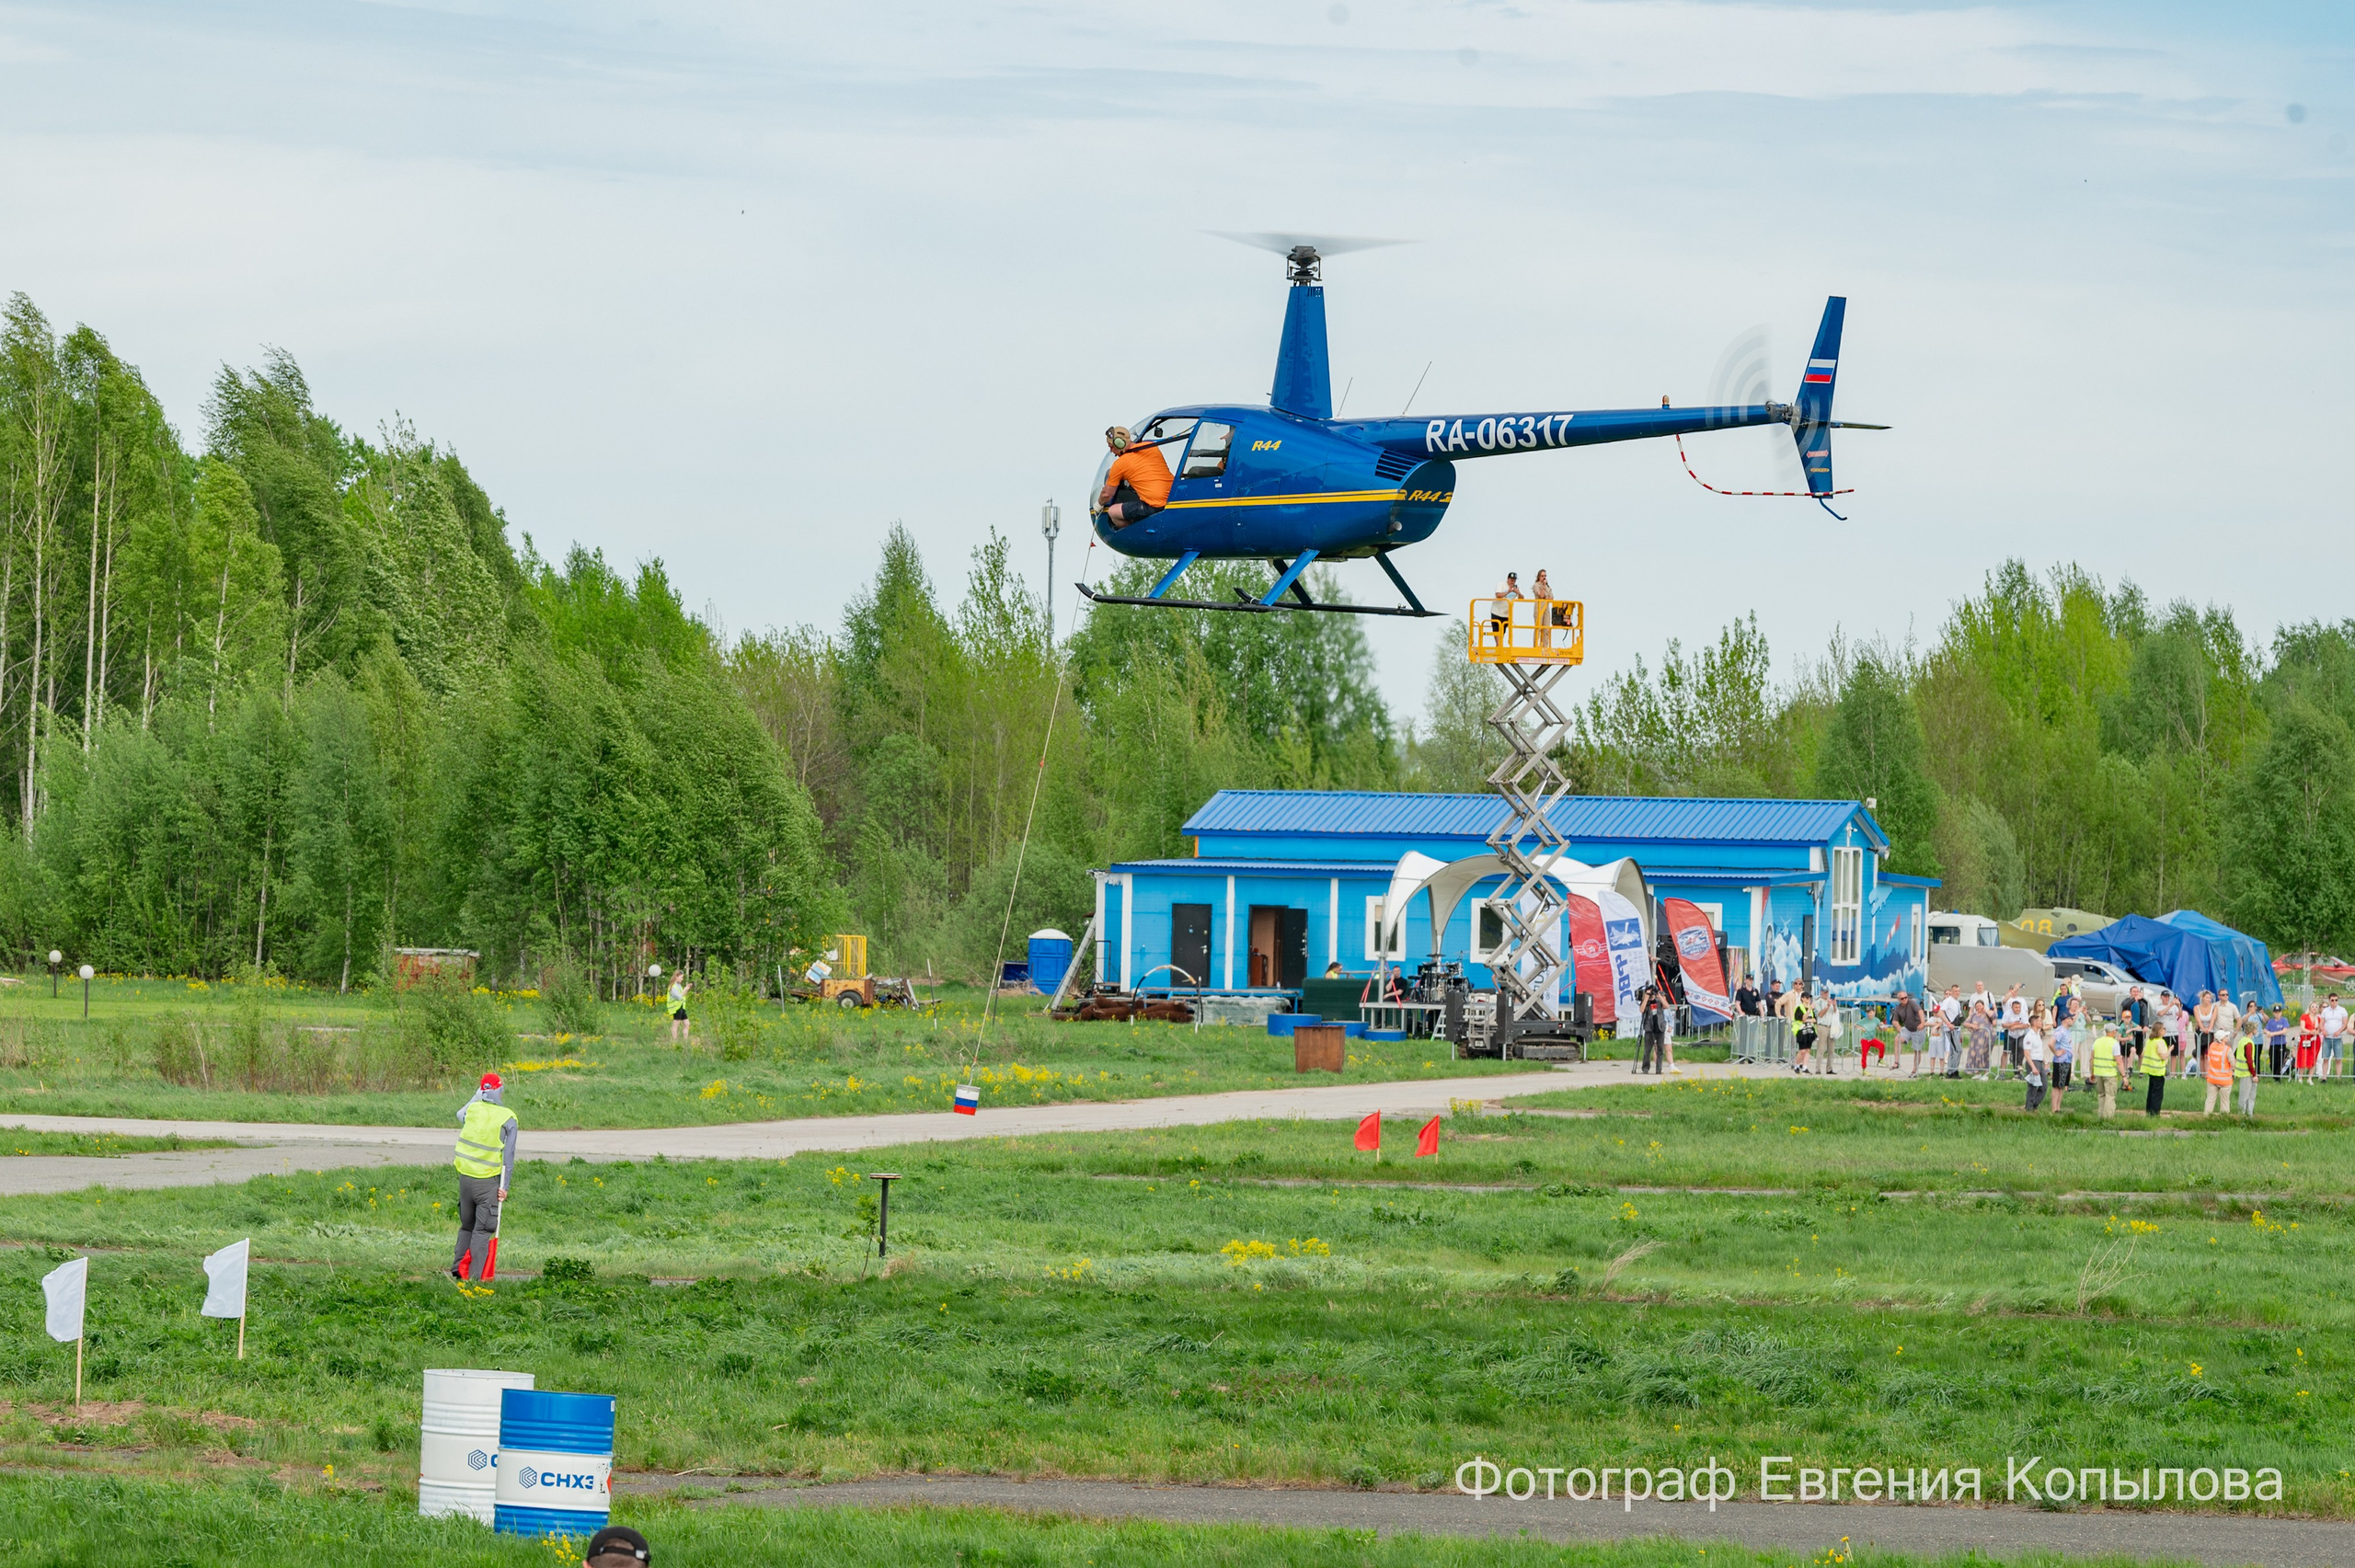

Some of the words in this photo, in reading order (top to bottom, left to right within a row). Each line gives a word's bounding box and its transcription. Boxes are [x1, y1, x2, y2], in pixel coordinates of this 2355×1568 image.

[1426, 414, 1574, 452] RA-06317
[1251, 440, 1282, 452] R44
[1407, 489, 1442, 502] R44
